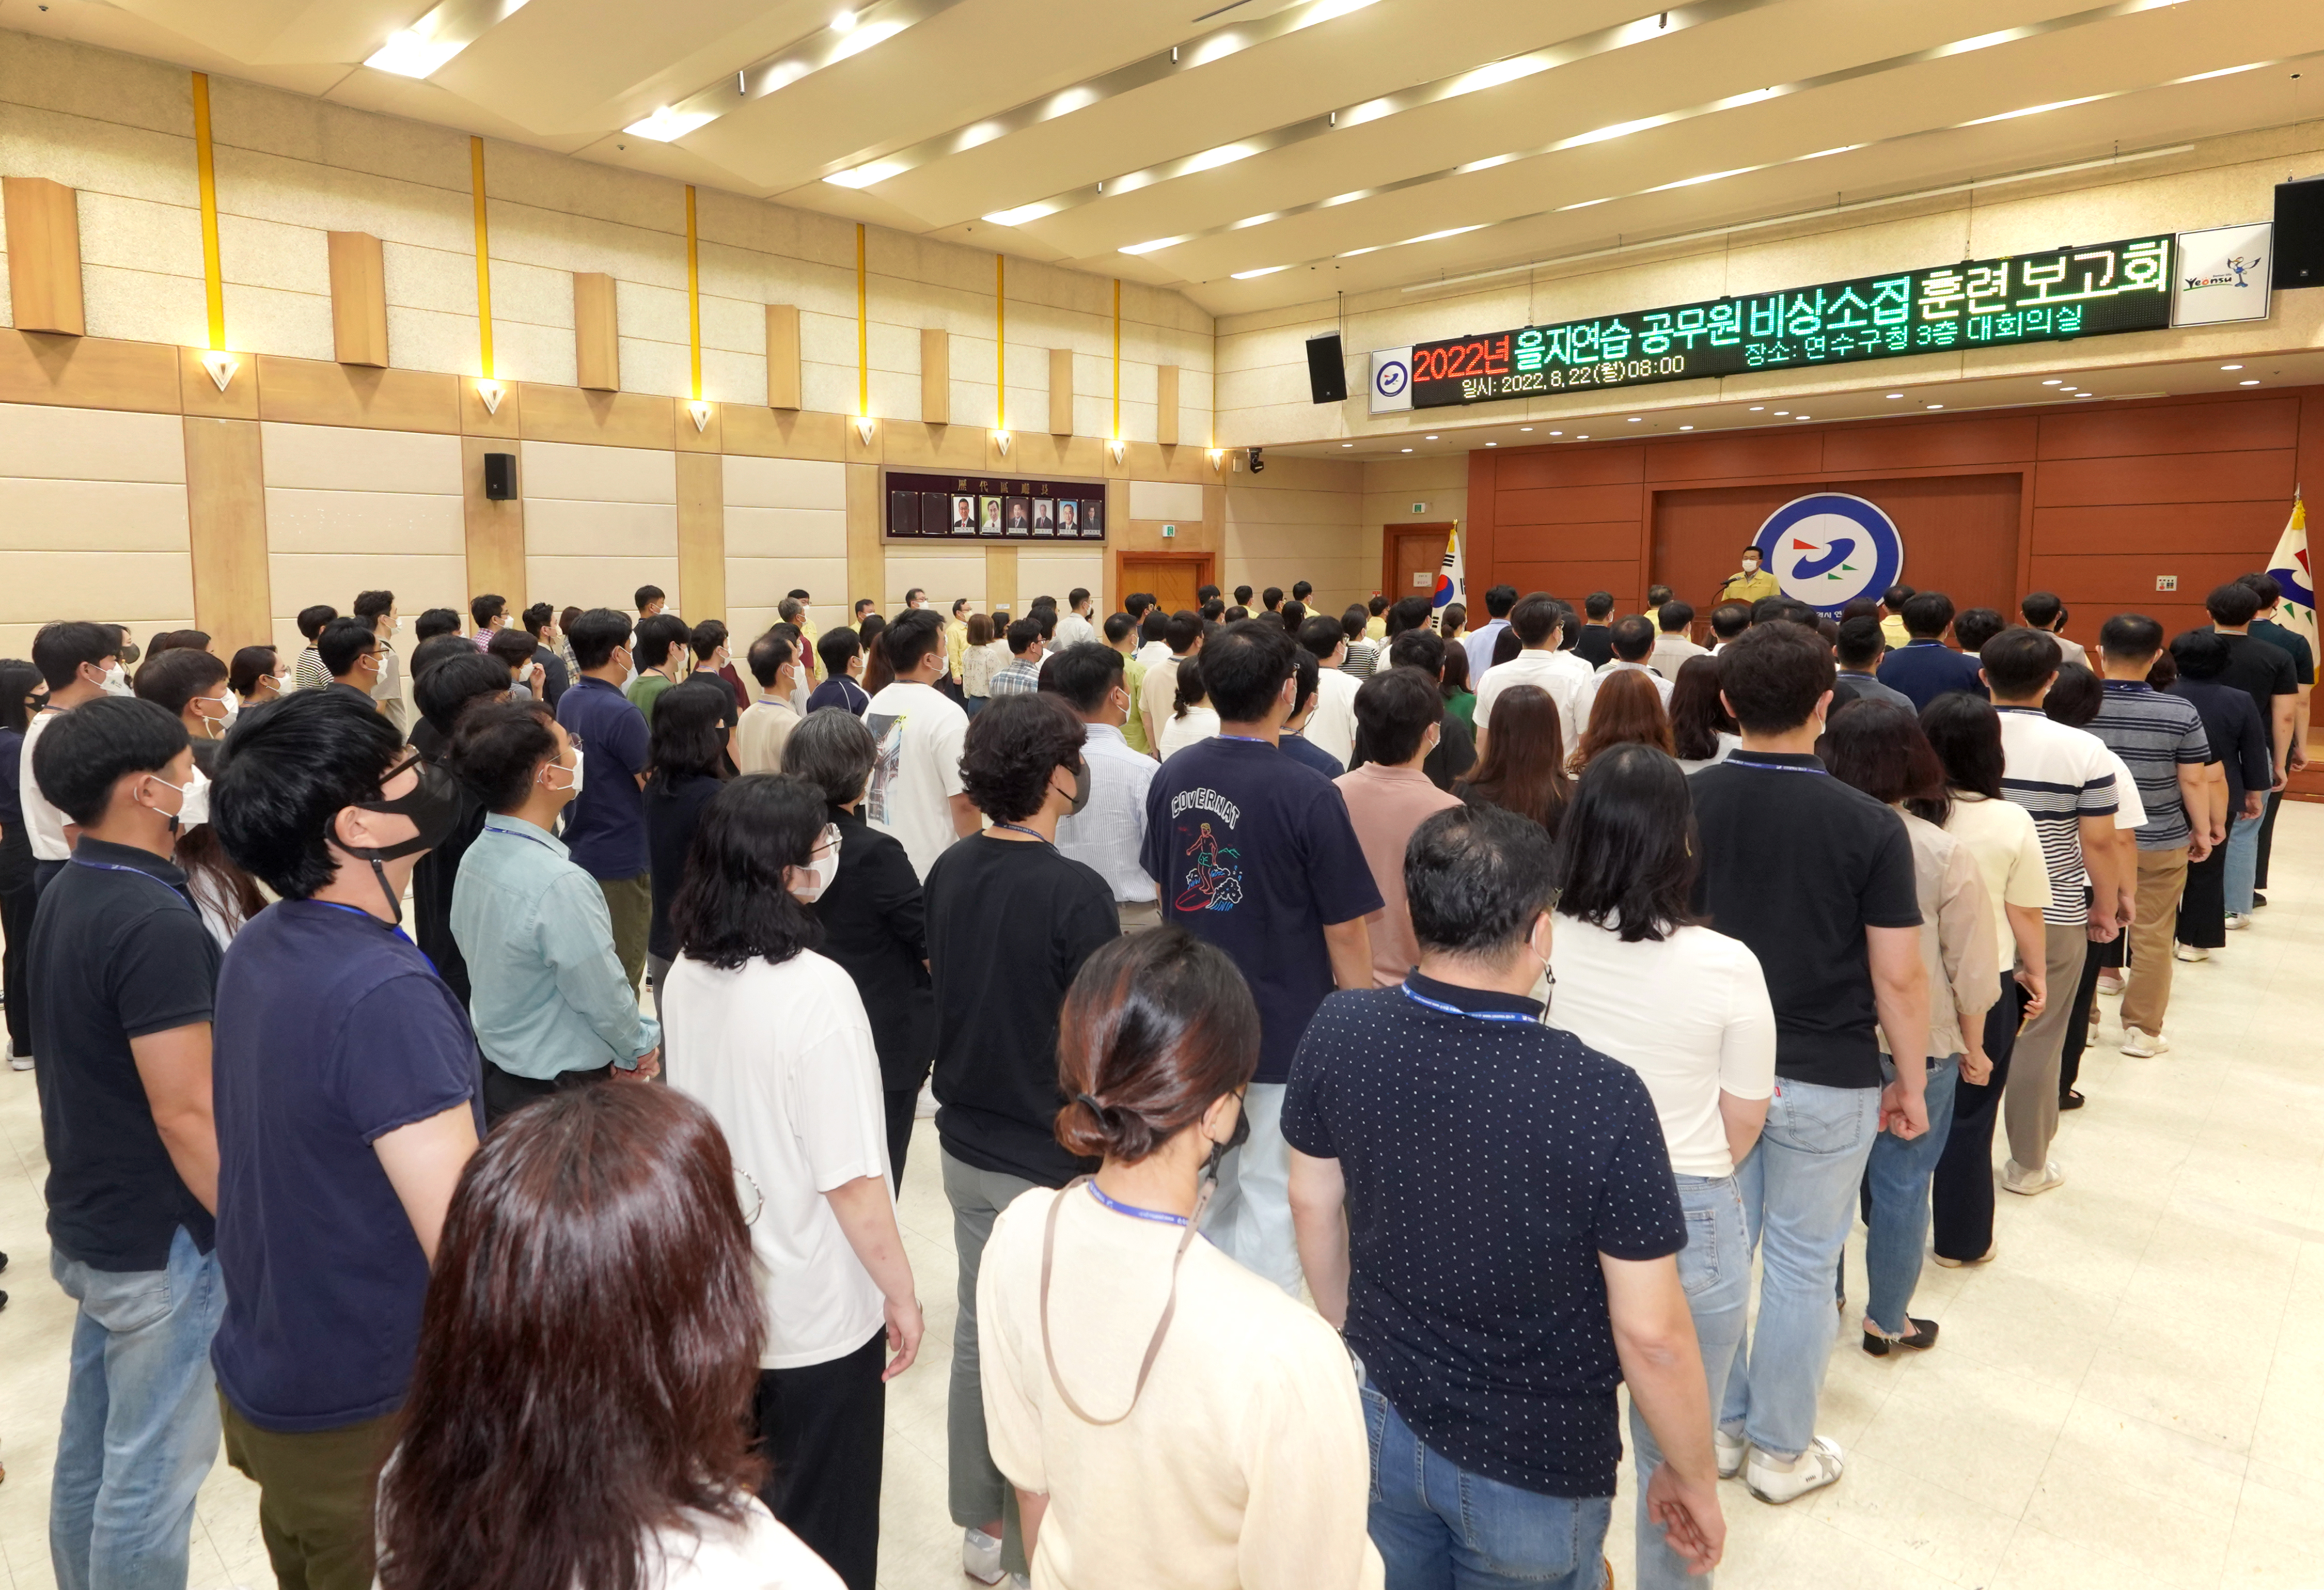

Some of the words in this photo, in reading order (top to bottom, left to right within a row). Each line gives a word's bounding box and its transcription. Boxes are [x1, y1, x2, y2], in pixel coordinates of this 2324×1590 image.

[2185, 277, 2232, 289] Yeonsu
[1414, 335, 1509, 382] 2022년
[1514, 318, 1632, 370] 을지연습
[1639, 300, 1741, 354] 공무원
[1750, 276, 1910, 338] 비상소집
[1918, 262, 2008, 320] 훈련
[2016, 240, 2169, 306] 보고회
[1745, 341, 1797, 366] 장소:
[1805, 325, 1908, 360] 연수구청
[1917, 320, 1958, 345] 3층
[1967, 305, 2081, 341] 대회의실
[1462, 376, 1497, 399] 일시:
[1171, 787, 1240, 830] COVERNAT
